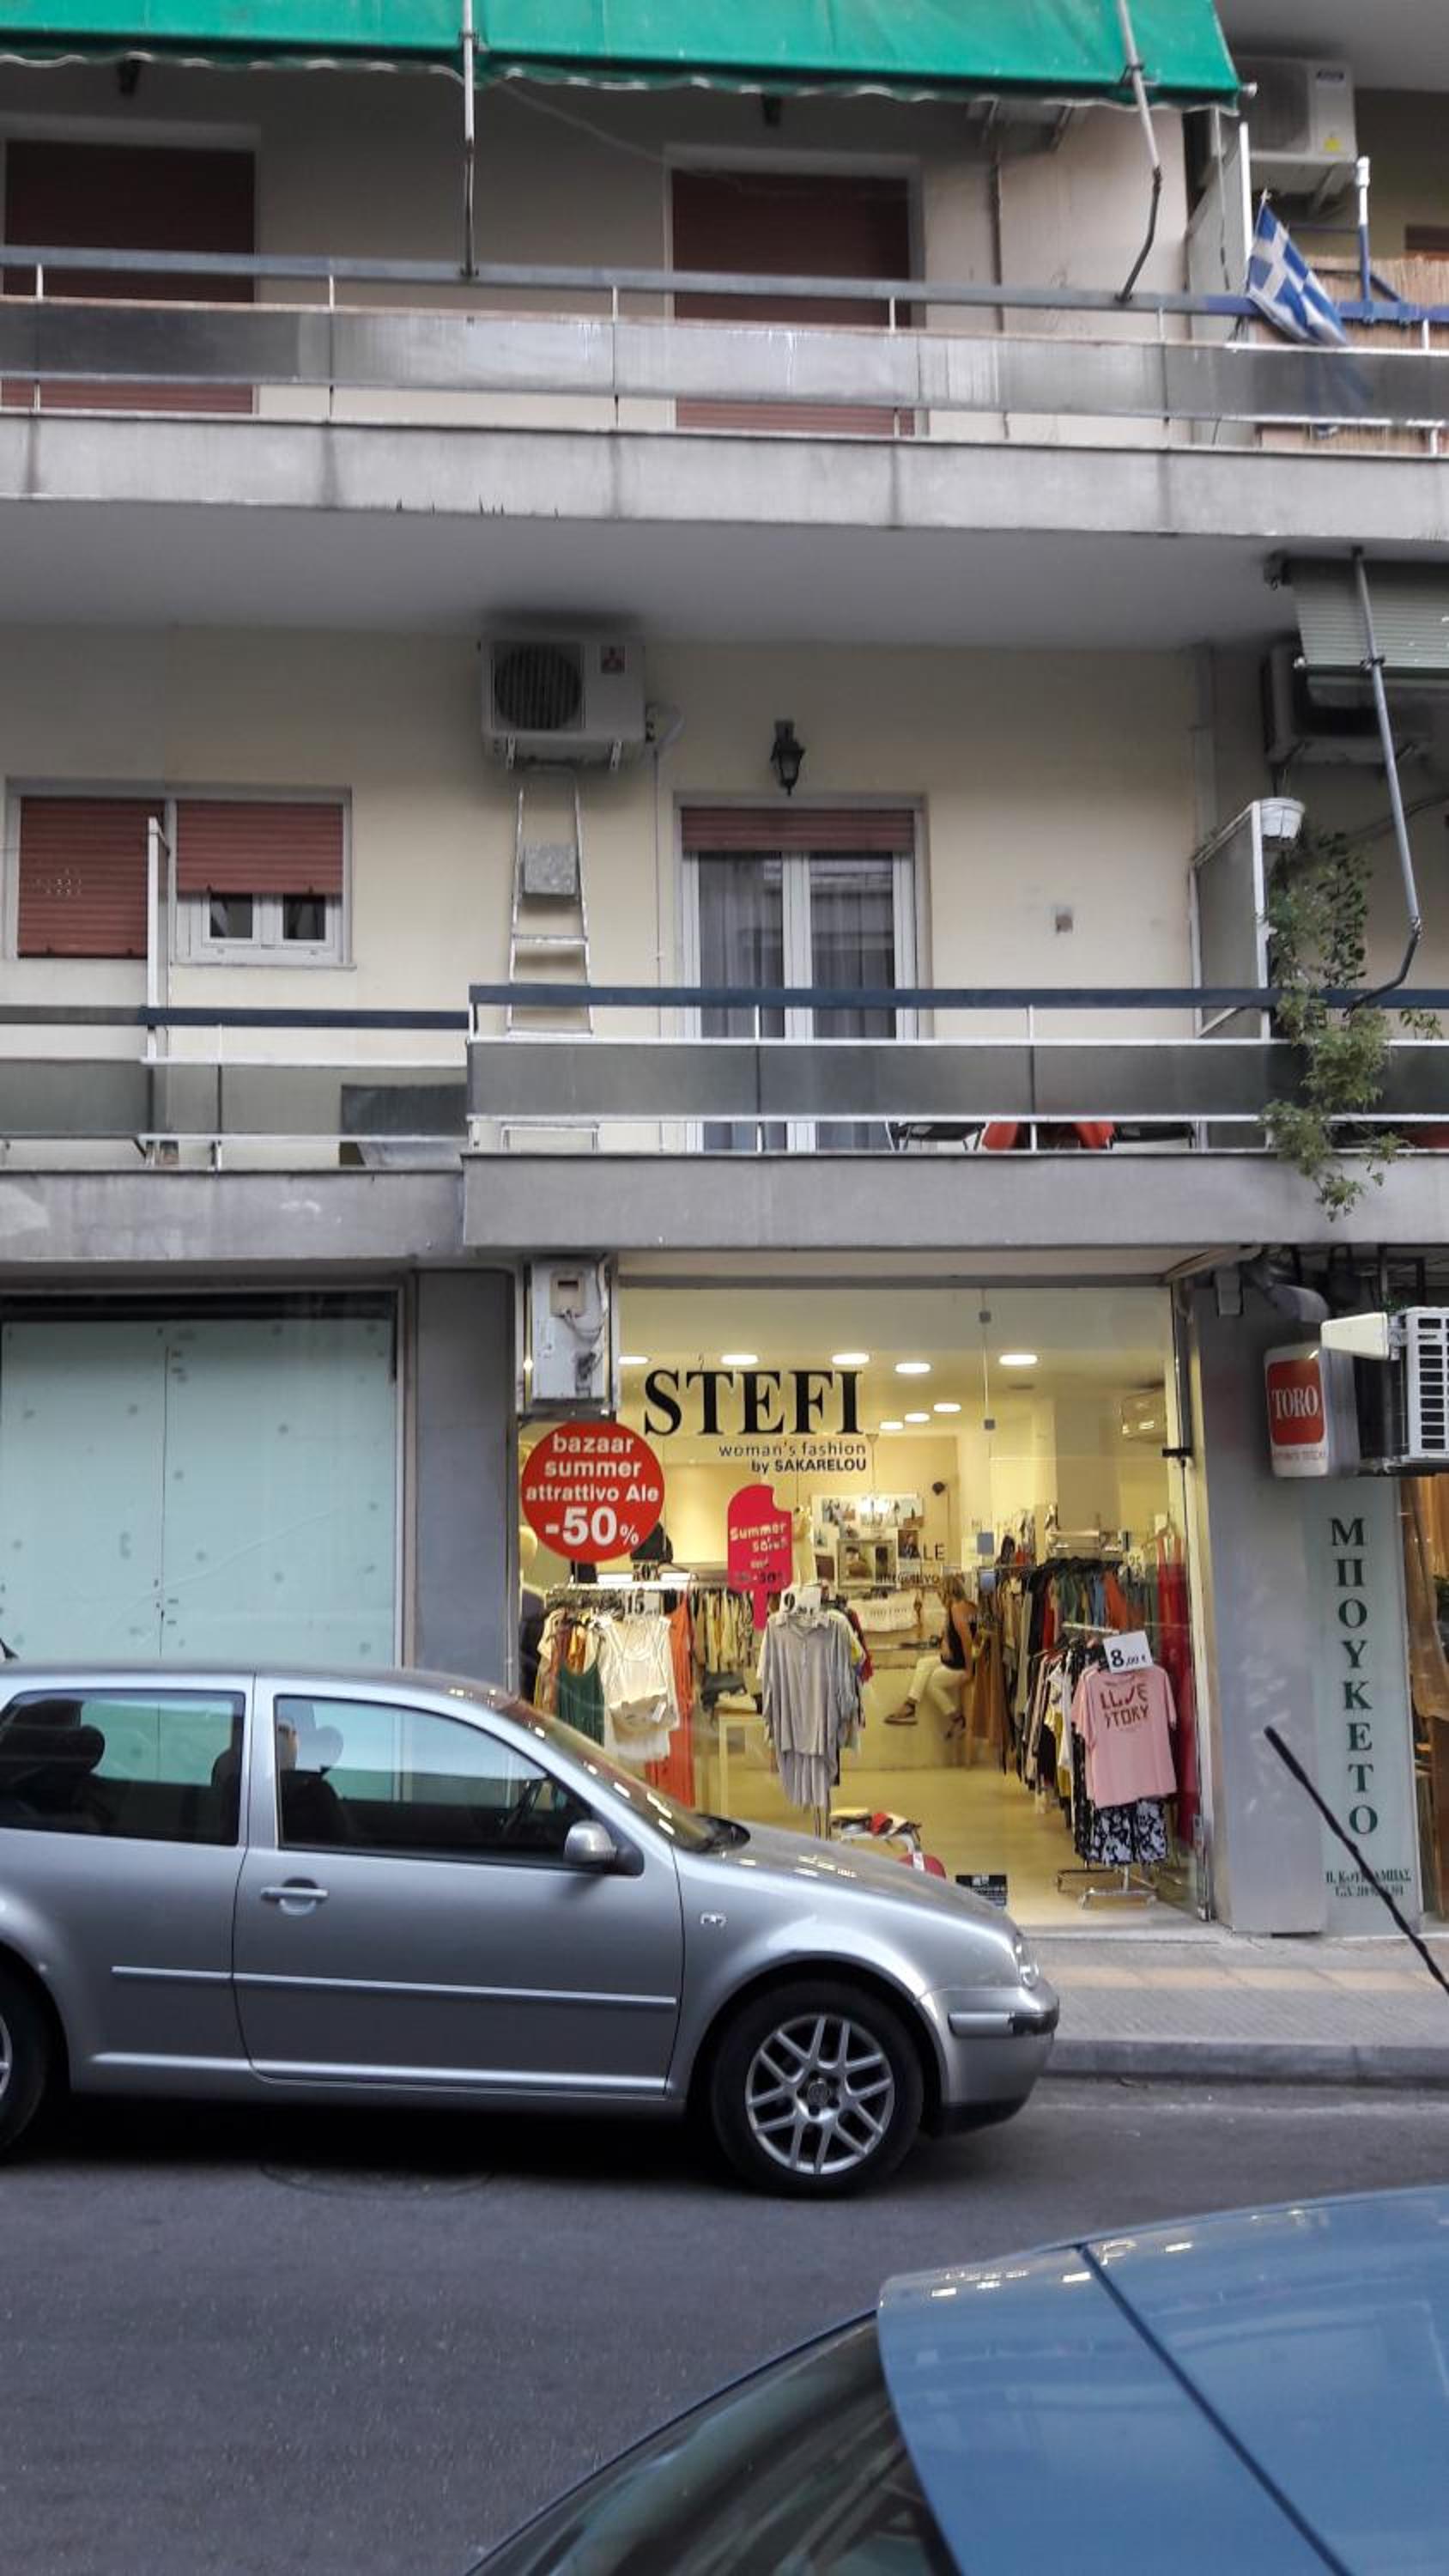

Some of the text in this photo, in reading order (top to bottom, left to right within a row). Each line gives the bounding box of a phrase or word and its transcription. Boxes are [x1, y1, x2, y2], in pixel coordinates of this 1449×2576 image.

[644, 1369, 864, 1437] STEFI
[1271, 1386, 1319, 1419] TORO
[553, 1433, 634, 1454] bazaar
[718, 1440, 866, 1457] woman's fashion
[544, 1461, 642, 1478] summer
[751, 1459, 867, 1474] by SAKARELOU
[526, 1484, 660, 1502] attrattivo Ale
[545, 1506, 640, 1546] -50%
[730, 1522, 787, 1541] Summer
[1330, 1517, 1379, 1835] ΜΠΟΥΚΕΤΟ
